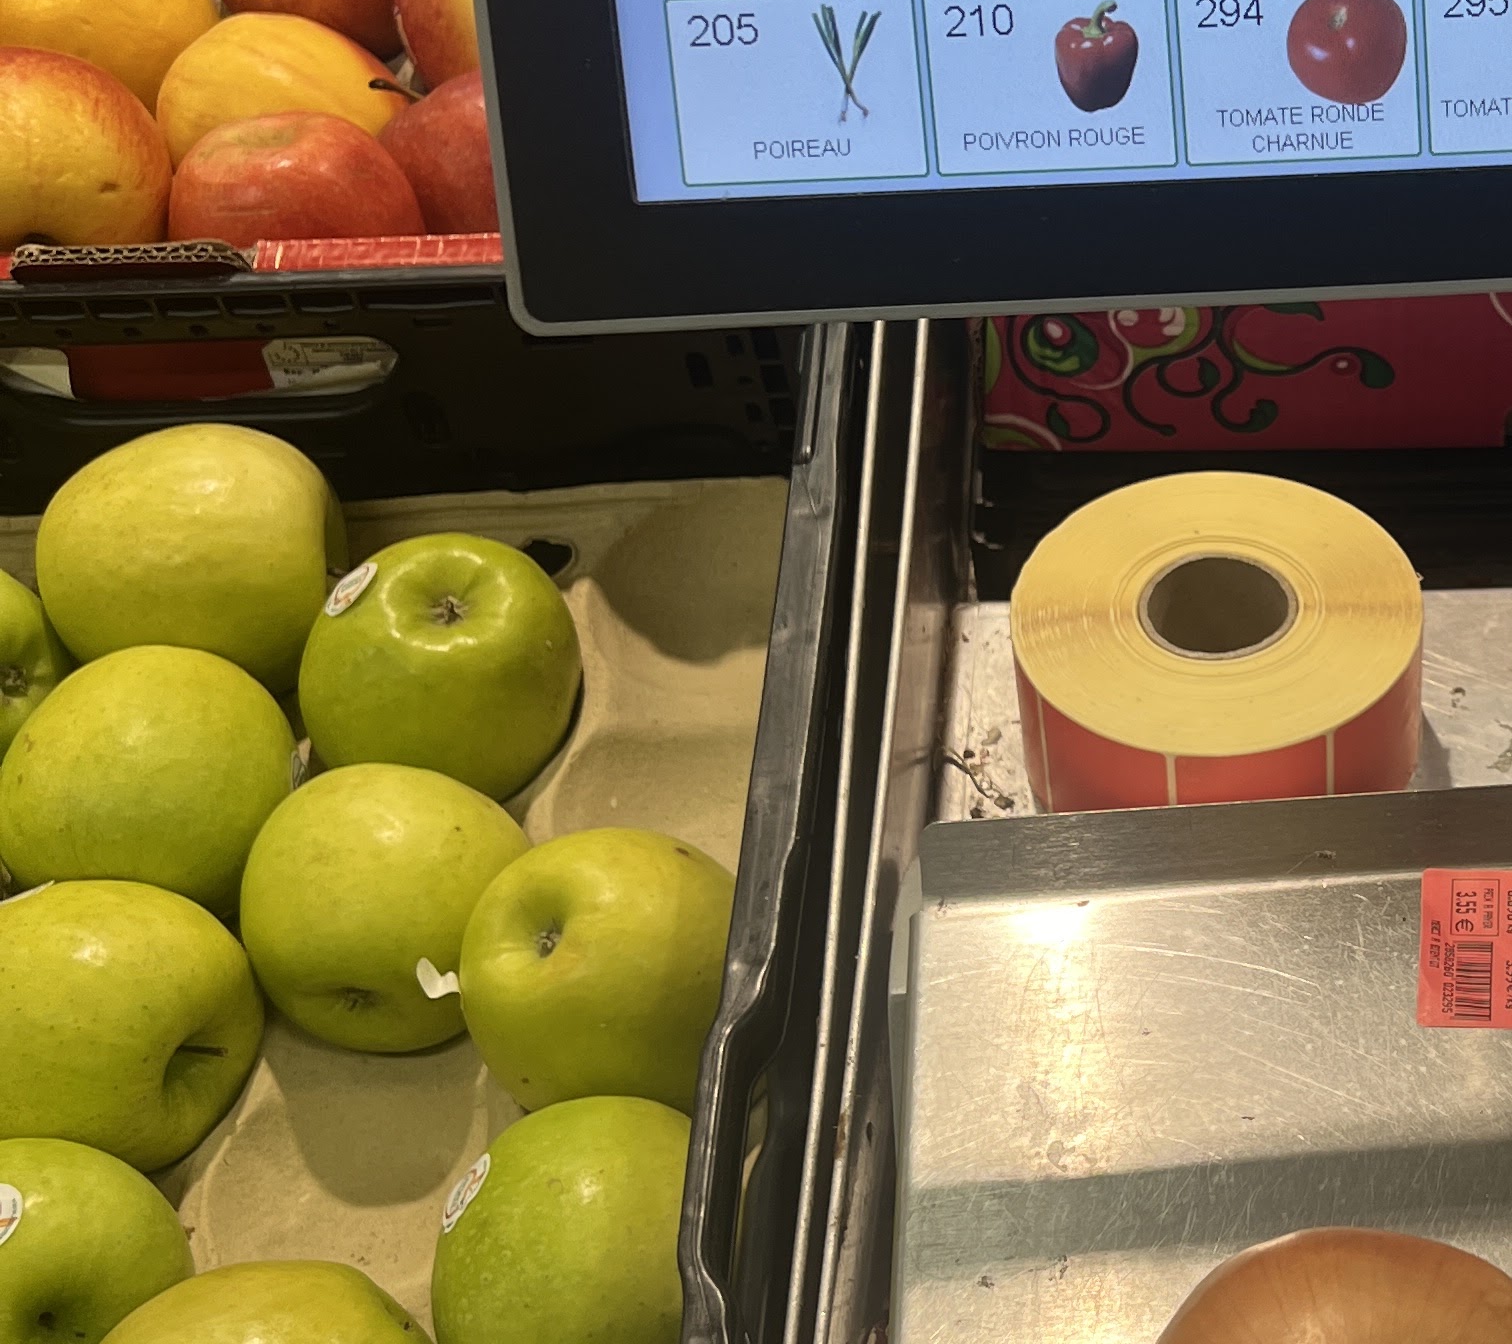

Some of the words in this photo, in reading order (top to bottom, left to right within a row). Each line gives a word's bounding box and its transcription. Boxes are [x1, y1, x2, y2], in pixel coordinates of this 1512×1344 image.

[688, 13, 759, 48] 205
[944, 4, 1014, 39] 210
[1216, 105, 1303, 128] TOMATE
[1310, 102, 1385, 125] RONDE
[754, 137, 852, 159] POIREAU
[963, 130, 1062, 152] POIVRON
[1068, 126, 1145, 149] ROUGE
[1252, 130, 1354, 153] CHARNUE
[1455, 890, 1477, 914] 3.55
[1454, 918, 1474, 932] €
